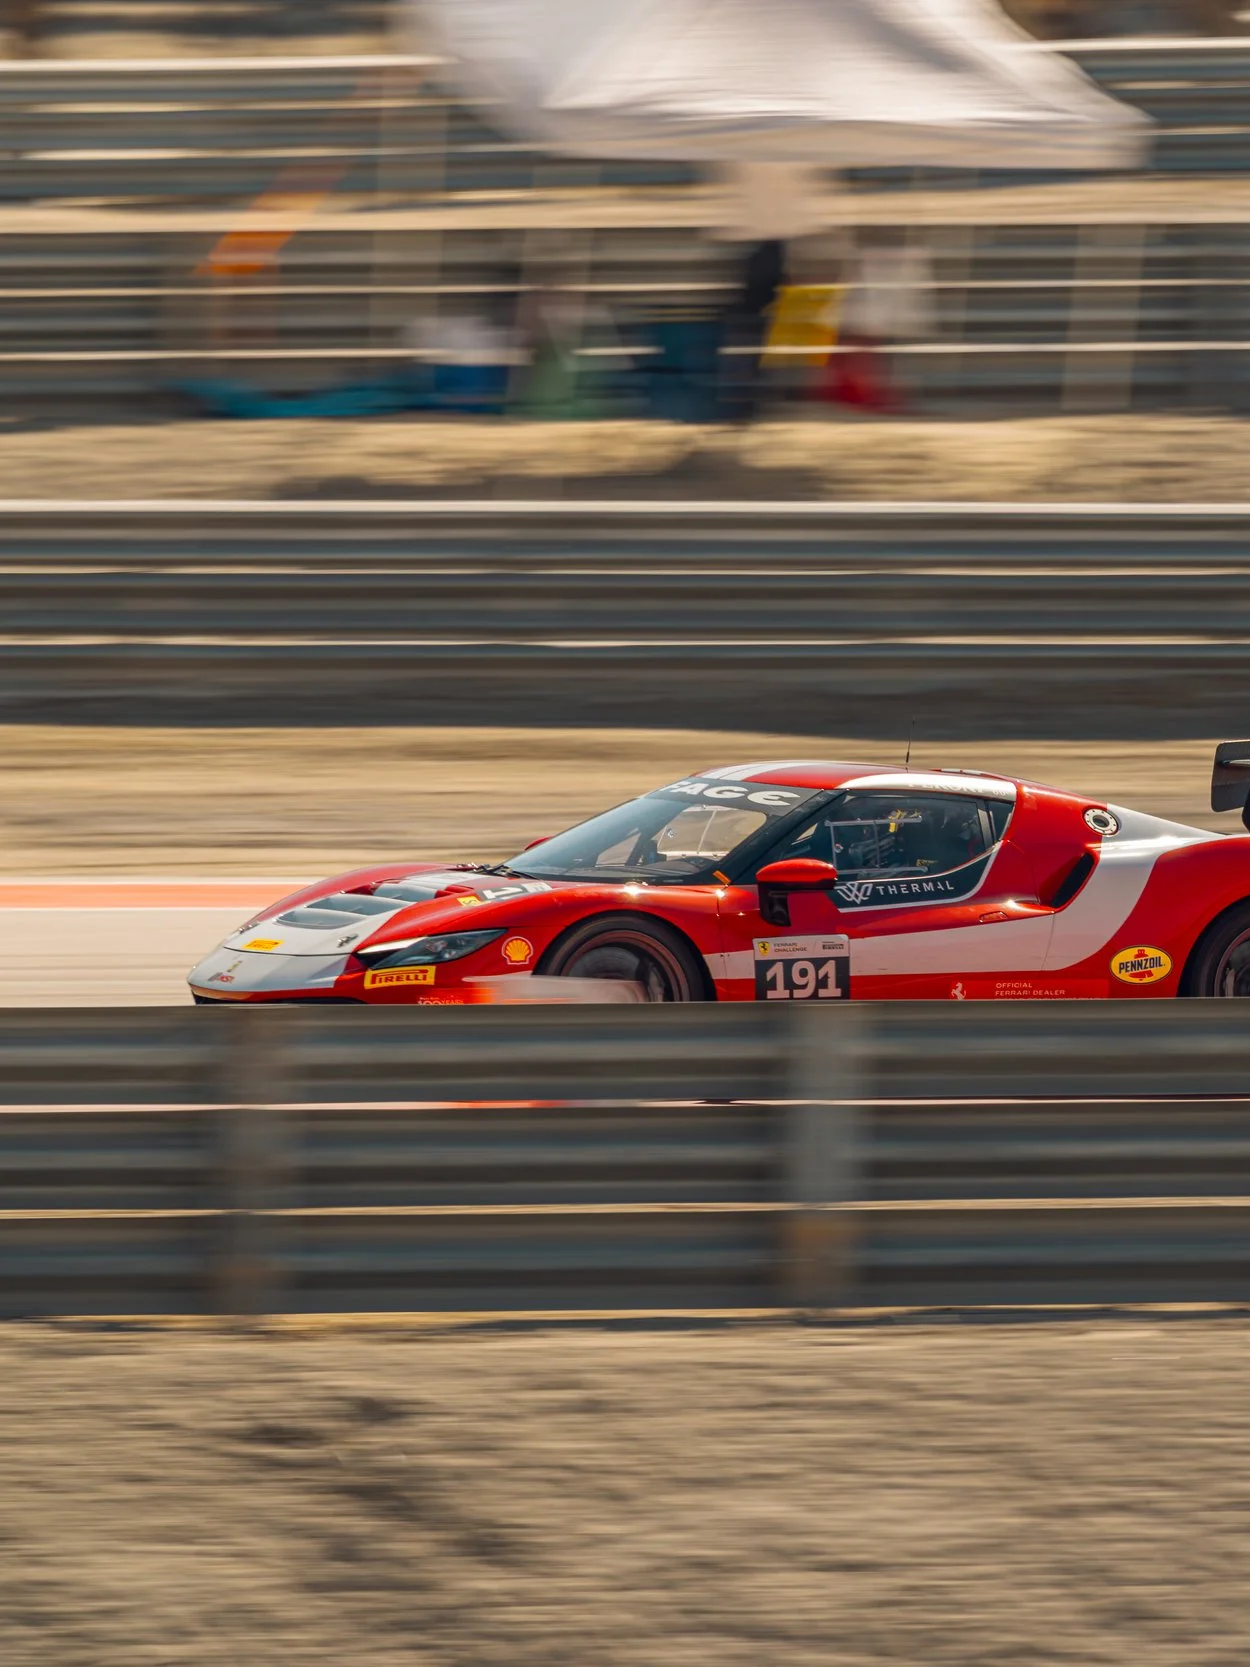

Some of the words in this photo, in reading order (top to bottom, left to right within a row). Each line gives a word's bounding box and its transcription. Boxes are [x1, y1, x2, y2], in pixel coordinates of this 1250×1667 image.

[875, 880, 955, 896] THERMAL
[1118, 956, 1164, 974] PENNZOIL
[371, 969, 429, 985] PIRELLI
[766, 959, 842, 999] 191
